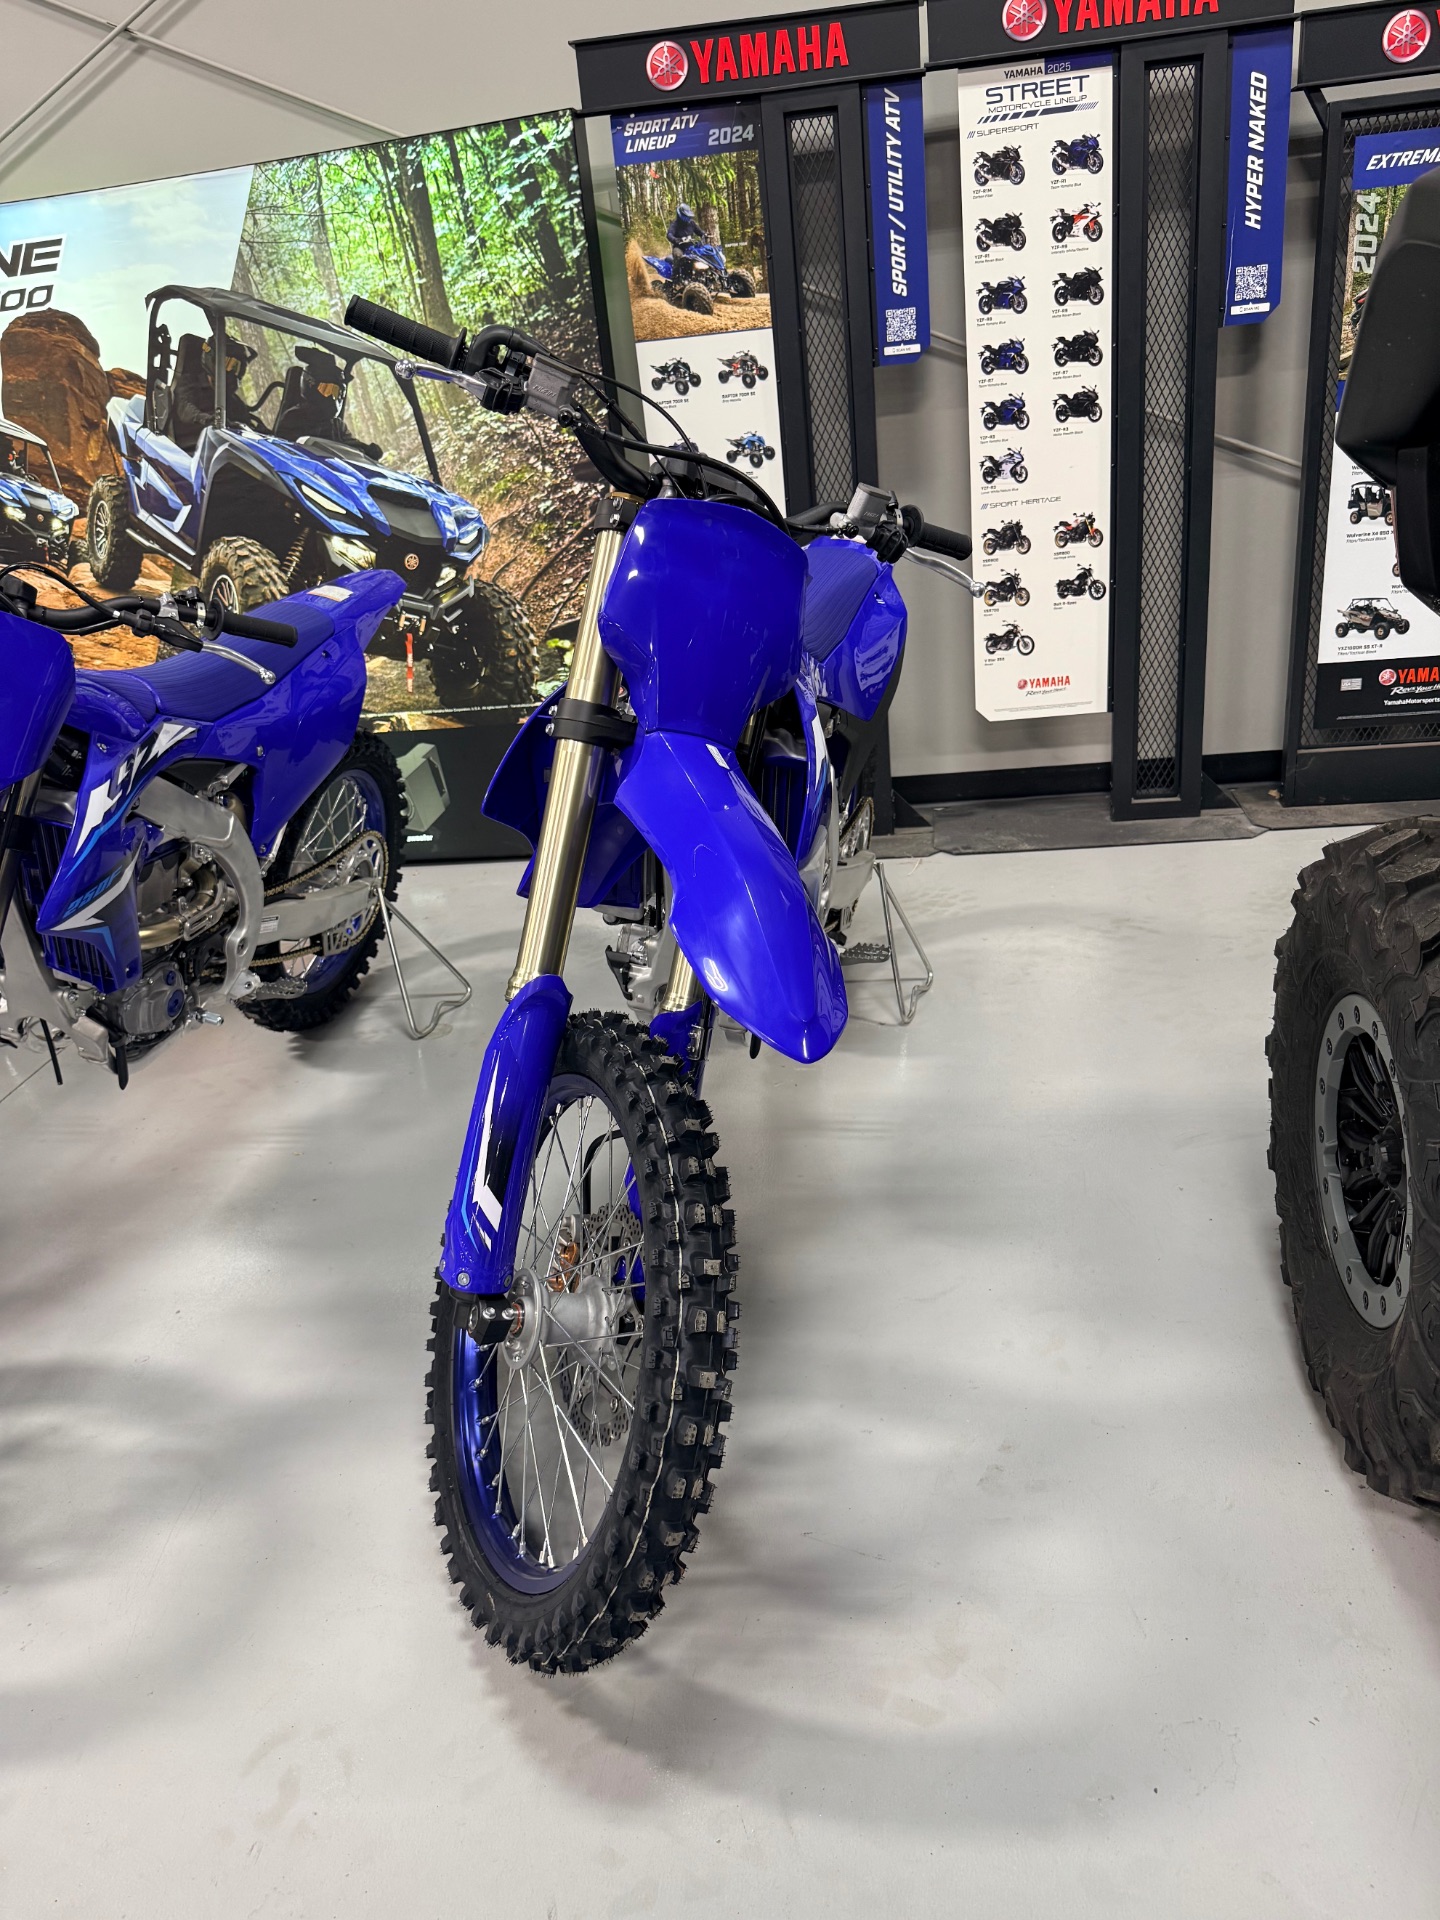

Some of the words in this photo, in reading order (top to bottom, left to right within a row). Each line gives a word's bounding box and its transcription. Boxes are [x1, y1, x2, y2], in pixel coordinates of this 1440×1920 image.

[690, 22, 849, 84] YAMAHA
[1004, 66, 1043, 79] YAMAHA
[1048, 62, 1071, 74] 2025
[985, 75, 1090, 105] STREET
[883, 88, 901, 134] ATV
[988, 99, 1052, 114] MOTORCYCLE
[1054, 94, 1088, 105] LINEUP
[1249, 71, 1268, 153] NAKED
[623, 116, 671, 137] SPORT
[670, 114, 699, 131] ATV
[708, 125, 755, 146] 2024
[976, 123, 1039, 137] SUPERSPORT
[625, 134, 676, 153] LINEUP
[884, 137, 905, 212] UTILITY
[1245, 155, 1263, 229] HYPER
[1353, 193, 1382, 274] 2024
[892, 230, 908, 297] SPORT
[989, 500, 1018, 509] SPORT
[1021, 496, 1061, 505] HERITAGE
[1029, 675, 1070, 688] YAMAHA
[1398, 667, 1440, 684] YAMA
